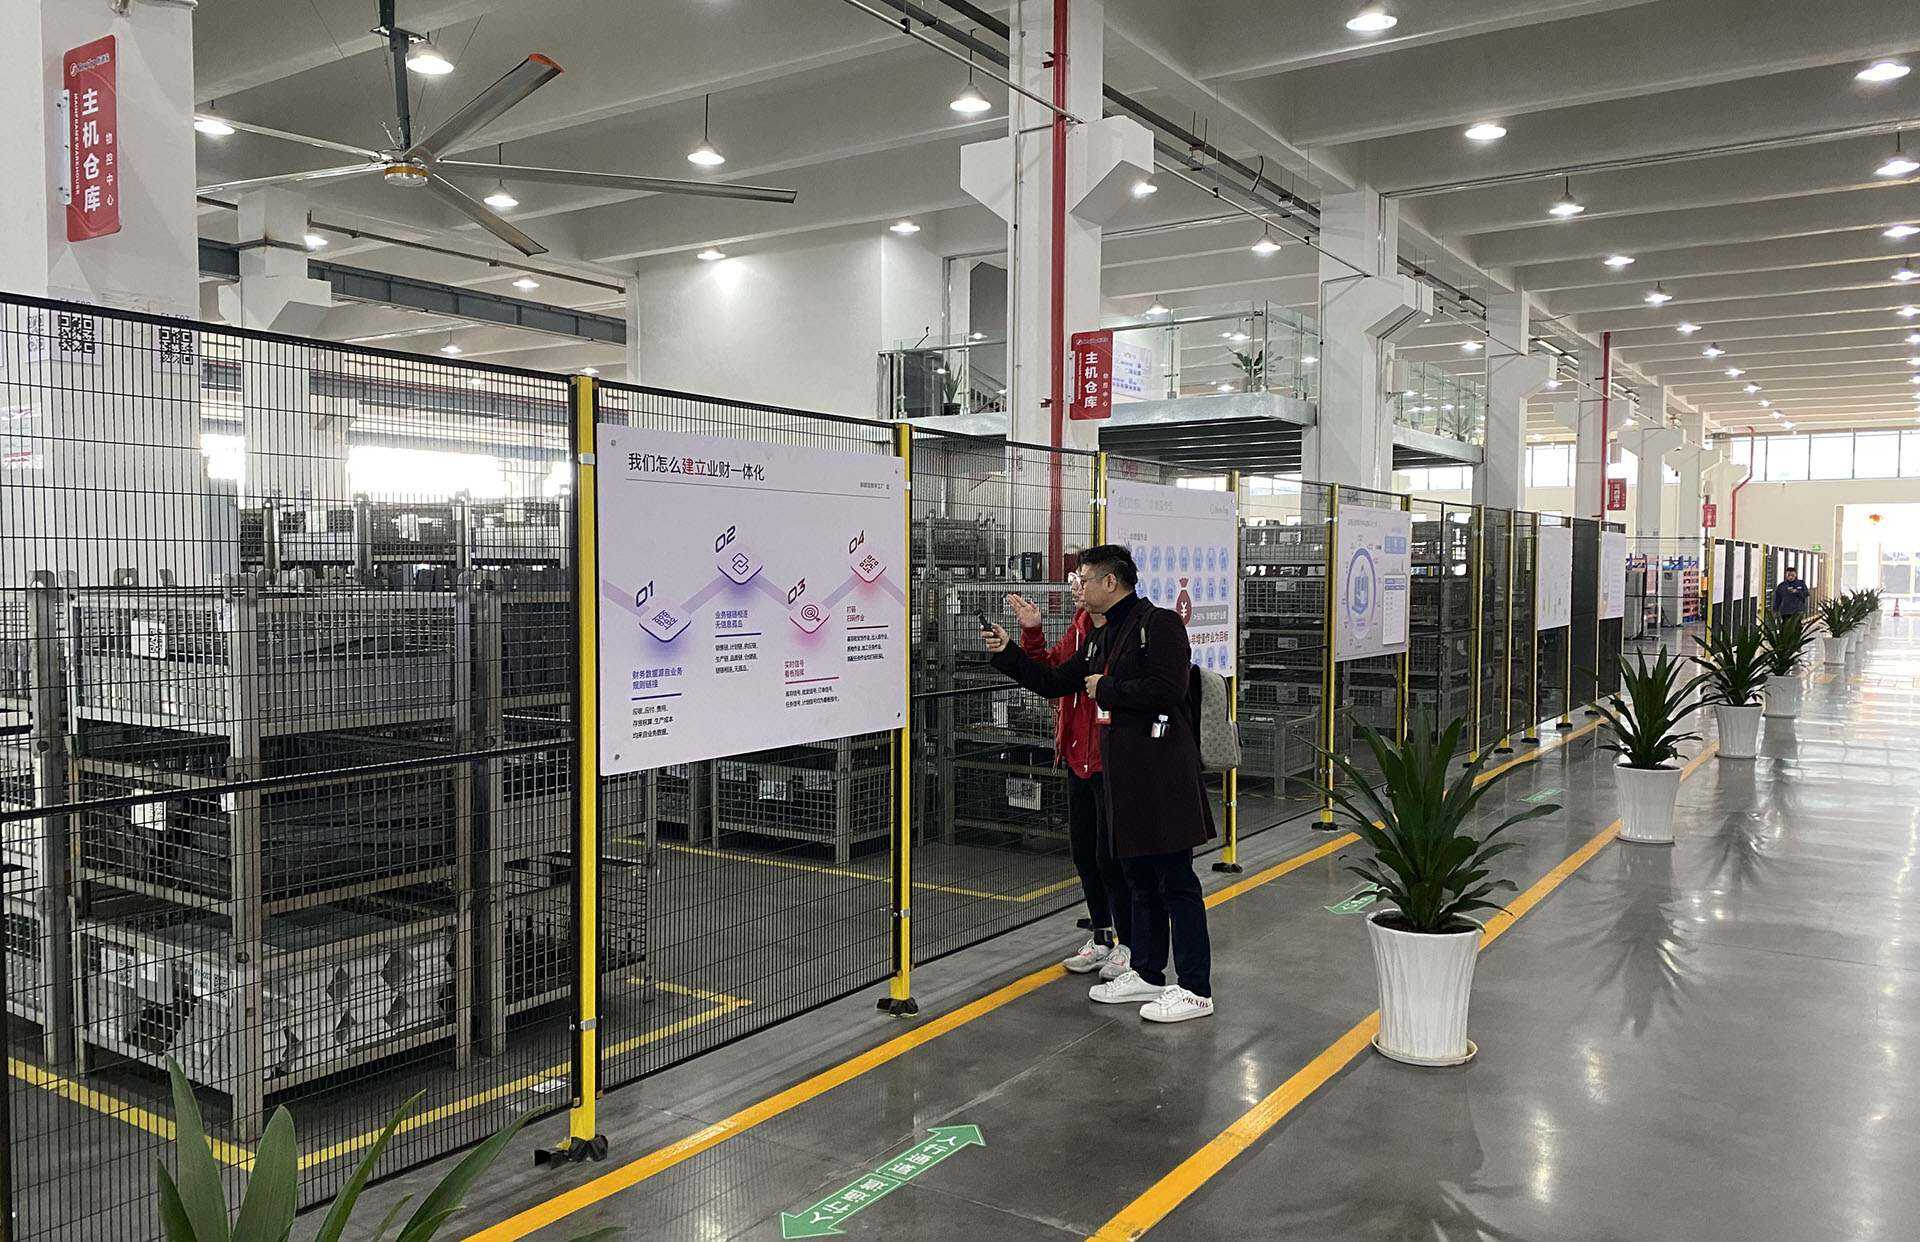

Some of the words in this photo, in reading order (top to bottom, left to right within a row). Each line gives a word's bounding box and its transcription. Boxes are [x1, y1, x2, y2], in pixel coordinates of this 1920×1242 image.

[82, 87, 101, 215] 主机仓库
[1084, 351, 1099, 409] 主机仓库
[628, 451, 765, 481] 我们怎么建立业财一体化
[715, 525, 737, 553] 02
[848, 529, 865, 555] 04
[635, 580, 654, 607] 01
[787, 577, 806, 605] 03
